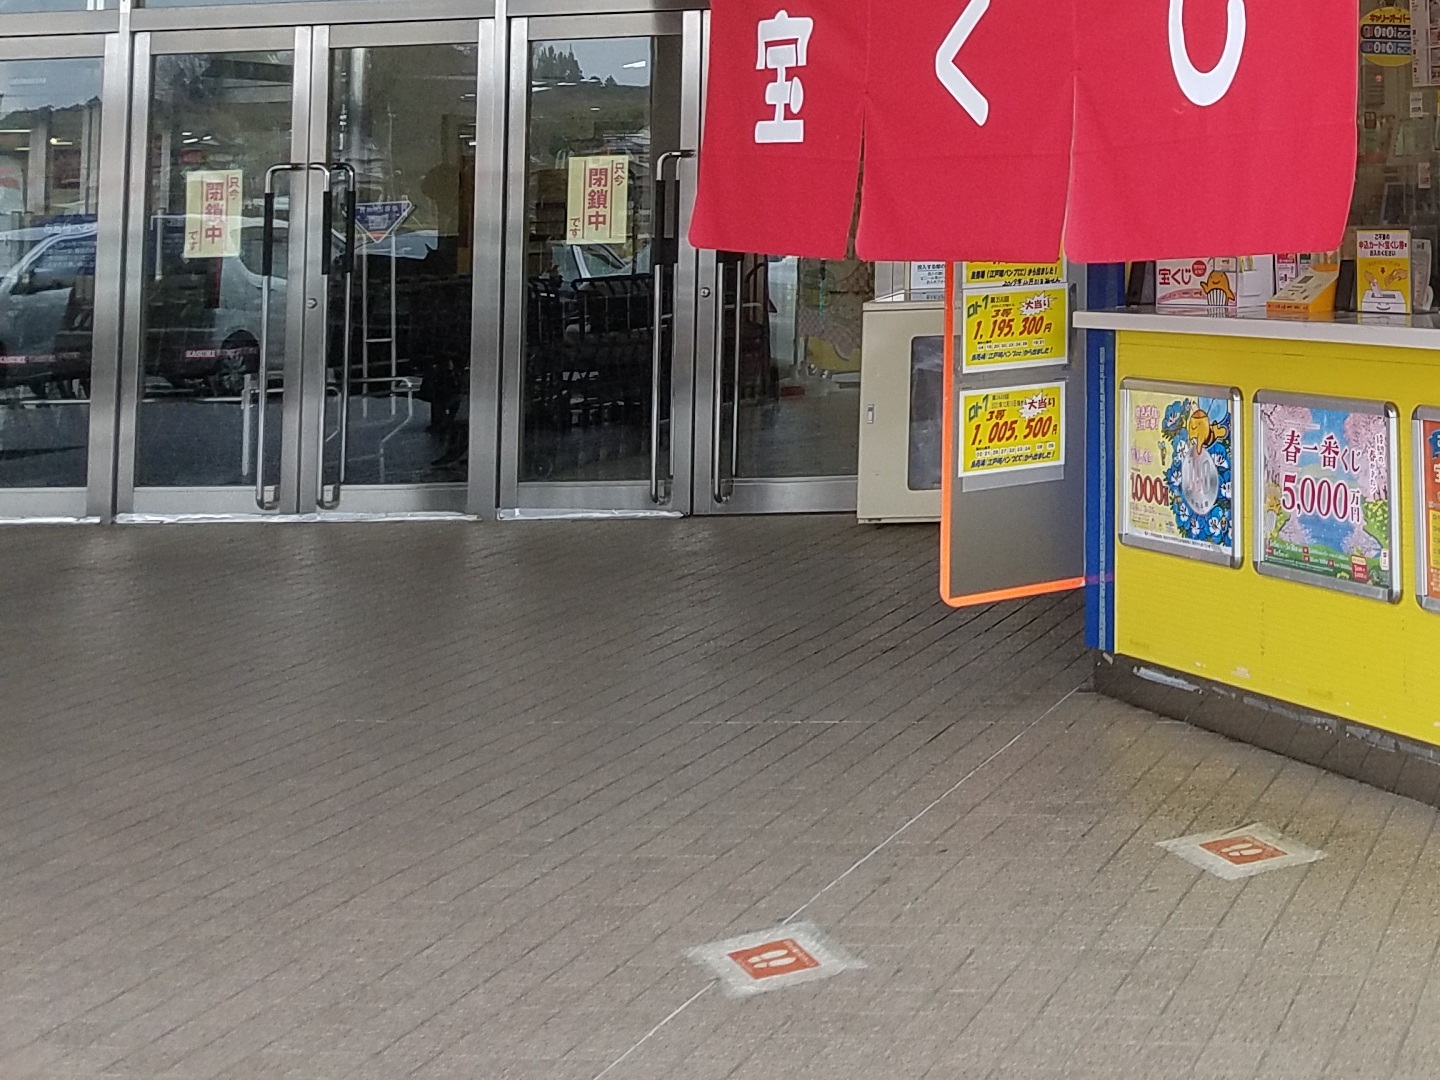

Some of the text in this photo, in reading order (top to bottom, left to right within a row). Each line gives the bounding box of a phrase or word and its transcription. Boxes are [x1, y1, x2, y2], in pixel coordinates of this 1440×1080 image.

[614, 162, 625, 186] 只今
[588, 168, 608, 231] 閉鎖中
[570, 218, 580, 238] です
[1159, 268, 1191, 285] 宝くじ
[991, 308, 1012, 318] 3等
[1025, 298, 1050, 310] 大当り
[1028, 398, 1055, 410] 大当り
[986, 409, 1006, 421] 3等
[1282, 430, 1360, 472] 春一番くじ
[1282, 474, 1360, 522] 5,000万円
